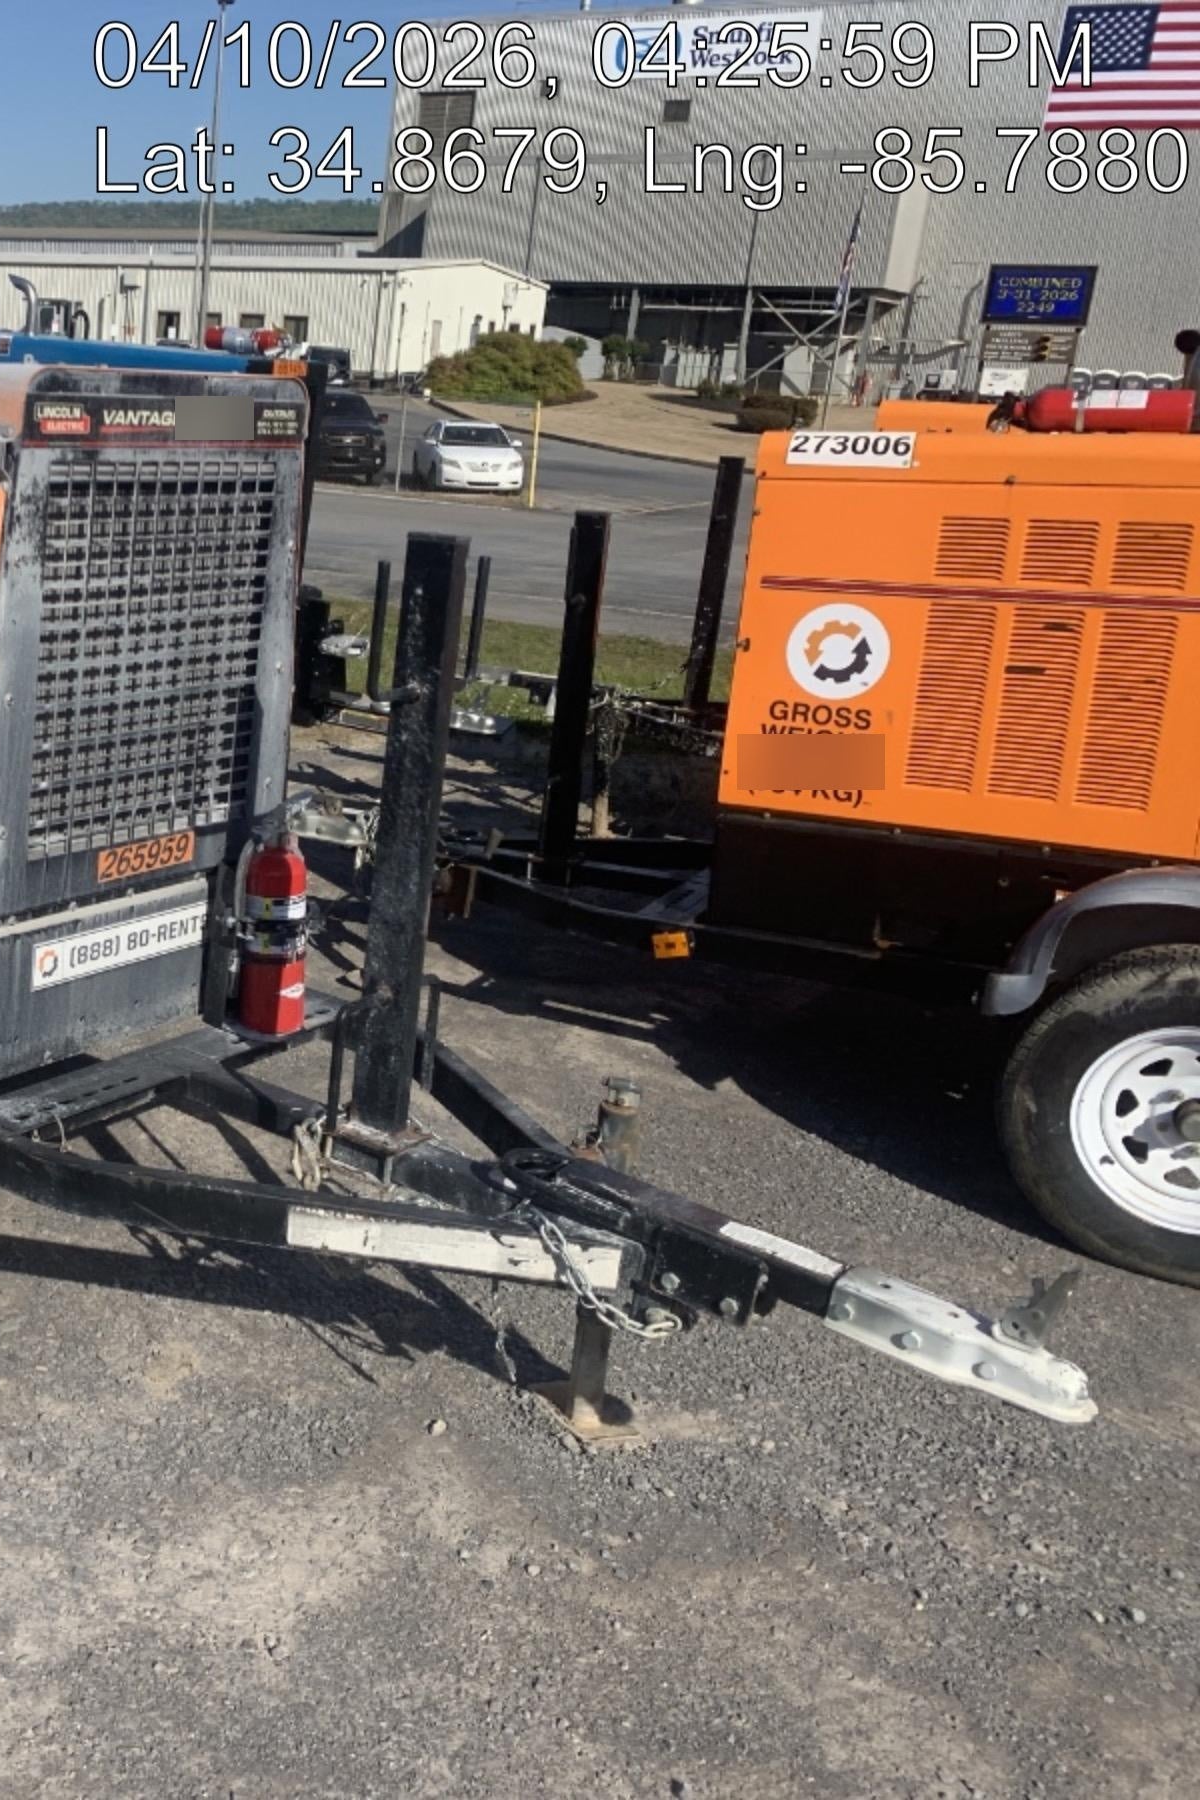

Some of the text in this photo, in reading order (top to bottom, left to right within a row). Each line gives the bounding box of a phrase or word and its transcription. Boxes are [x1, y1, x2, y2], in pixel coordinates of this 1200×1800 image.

[103, 408, 176, 427] VANTAG
[790, 435, 912, 457] 273006
[769, 700, 872, 731] GROSS
[99, 833, 189, 880] 265959
[69, 935, 121, 969] (888)
